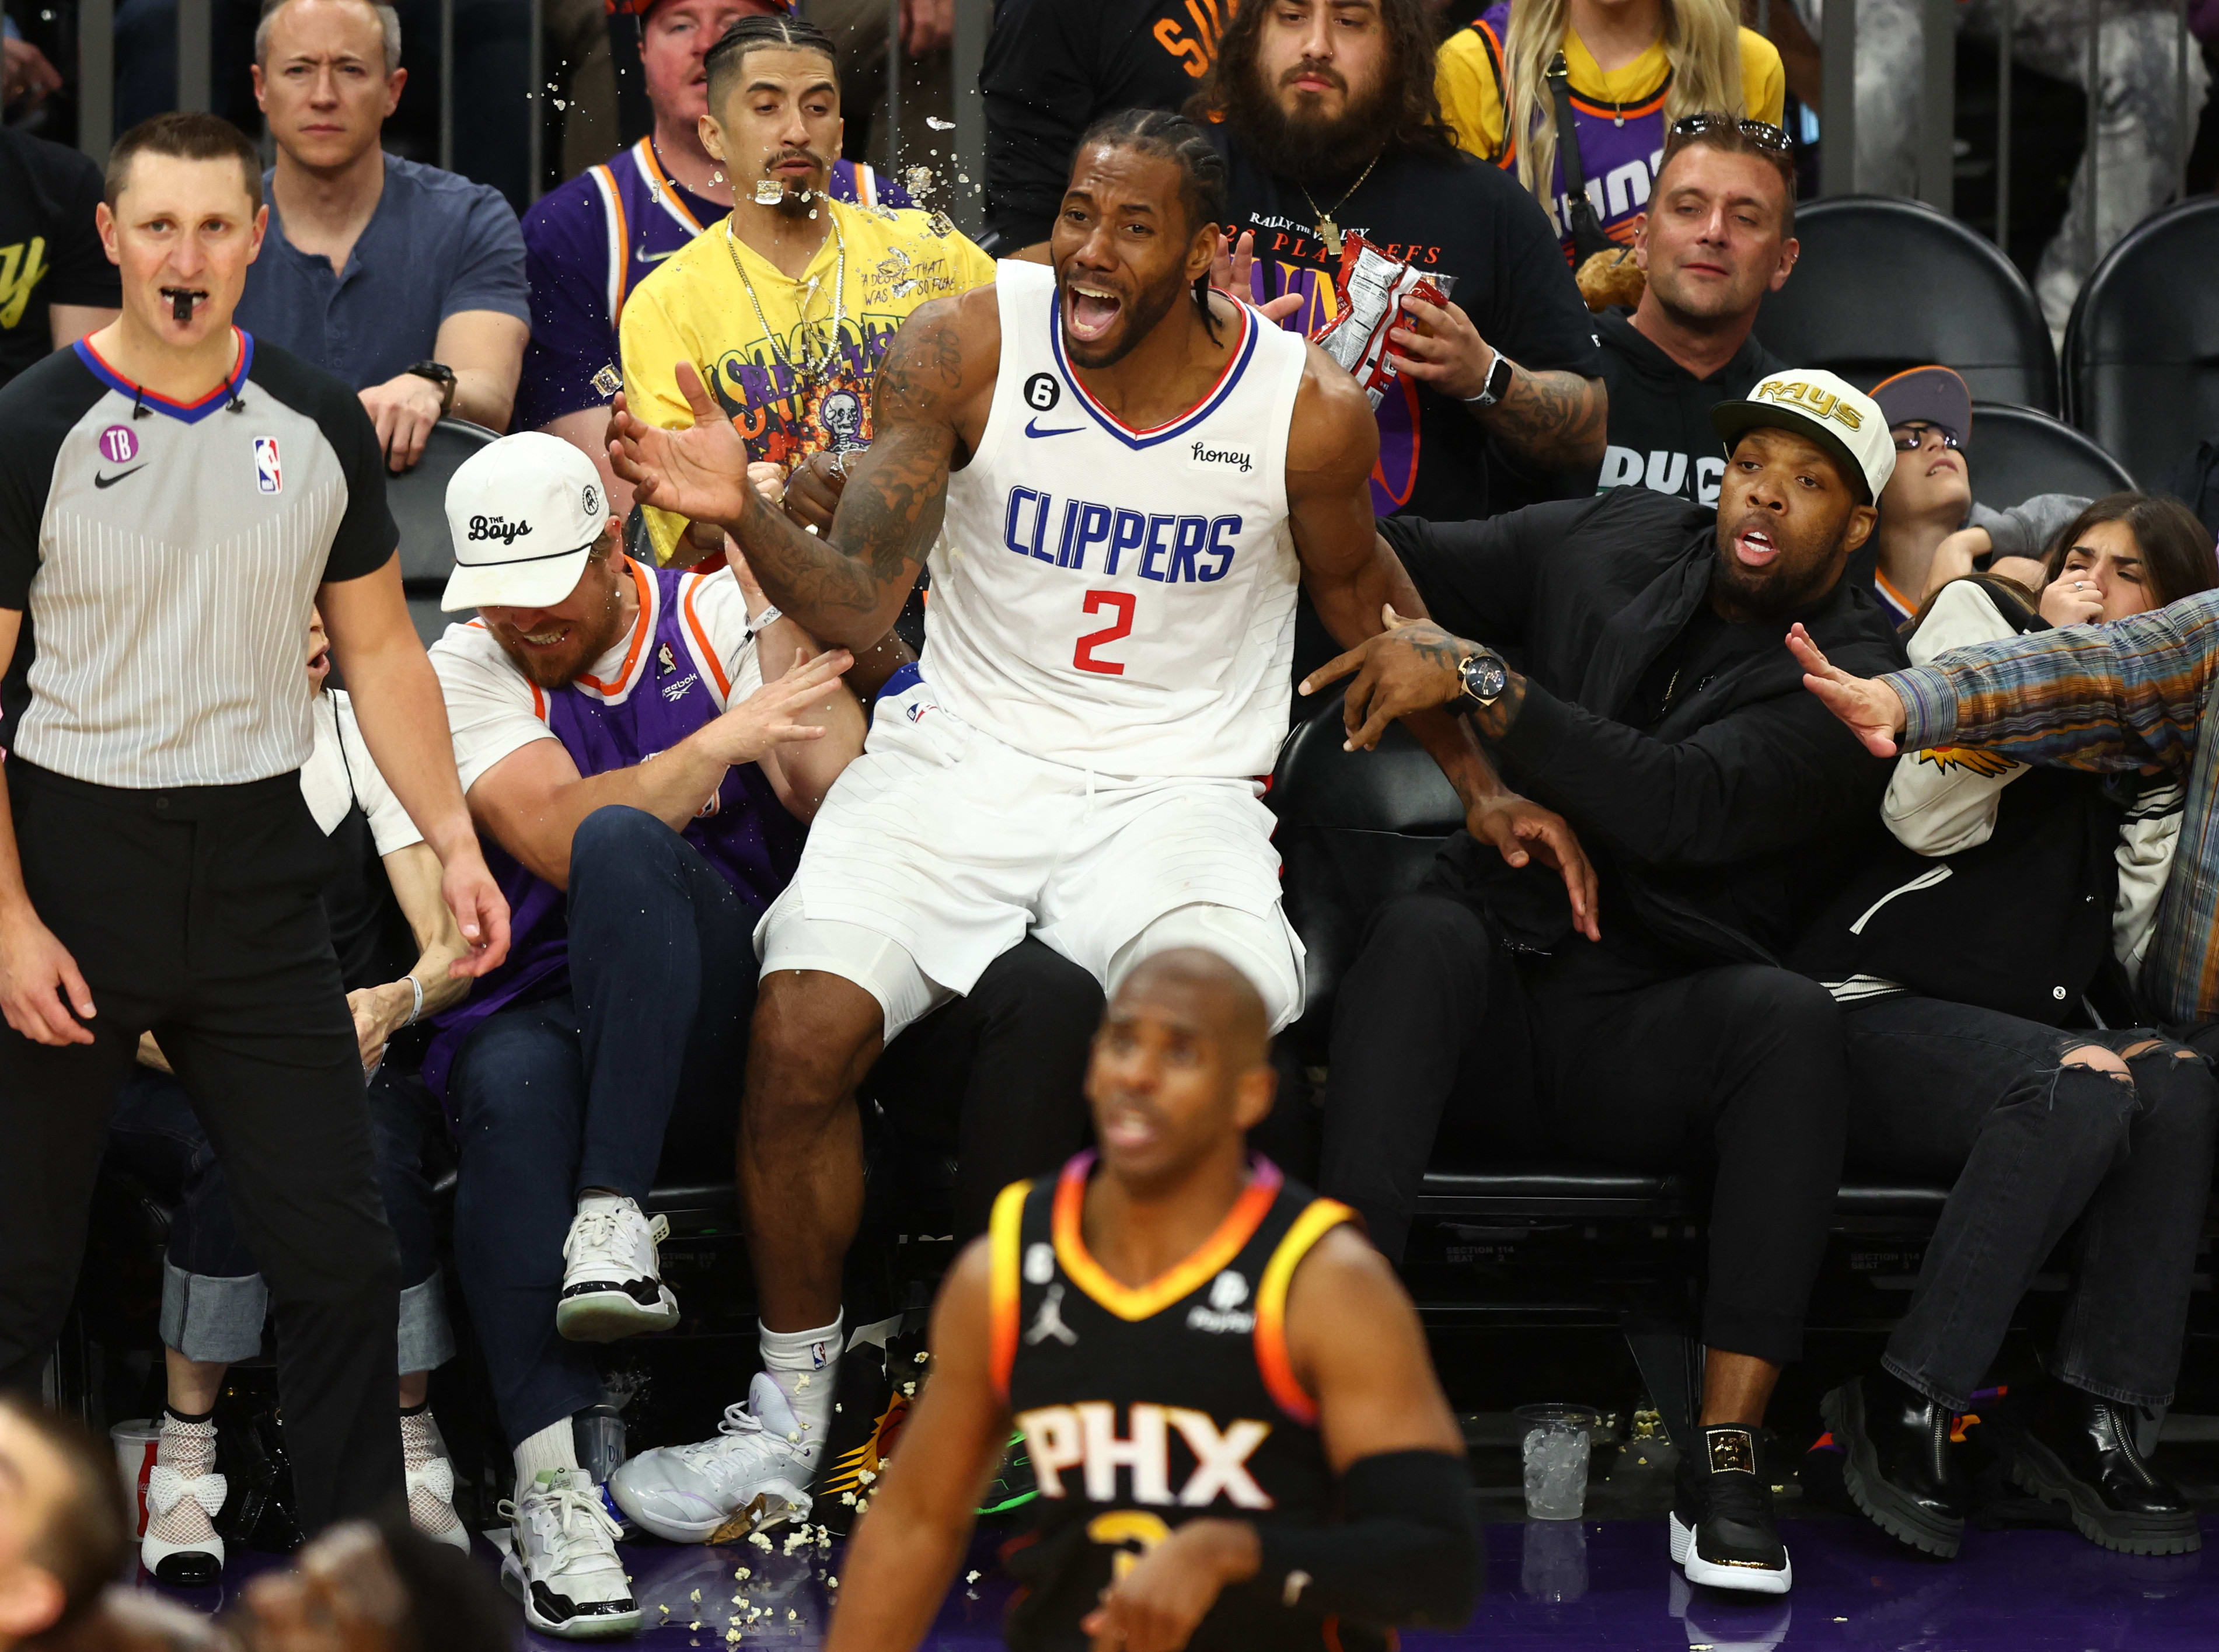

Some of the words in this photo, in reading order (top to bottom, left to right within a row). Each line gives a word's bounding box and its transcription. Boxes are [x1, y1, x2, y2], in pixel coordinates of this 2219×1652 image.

[1250, 212, 1293, 230] RALLY
[1296, 224, 1311, 235] THE
[913, 259, 945, 277] THAT
[864, 288, 888, 306] WAS
[917, 280, 929, 295] SO
[1031, 378, 1053, 407] 6
[1756, 380, 1865, 432] RAYS
[106, 429, 131, 461] TB
[1191, 442, 1252, 473] honey
[468, 515, 532, 545] Boys
[1004, 485, 1243, 583] CLIPPERS
[1073, 589, 1136, 675] 2
[1015, 1400, 1275, 1511] PHX
